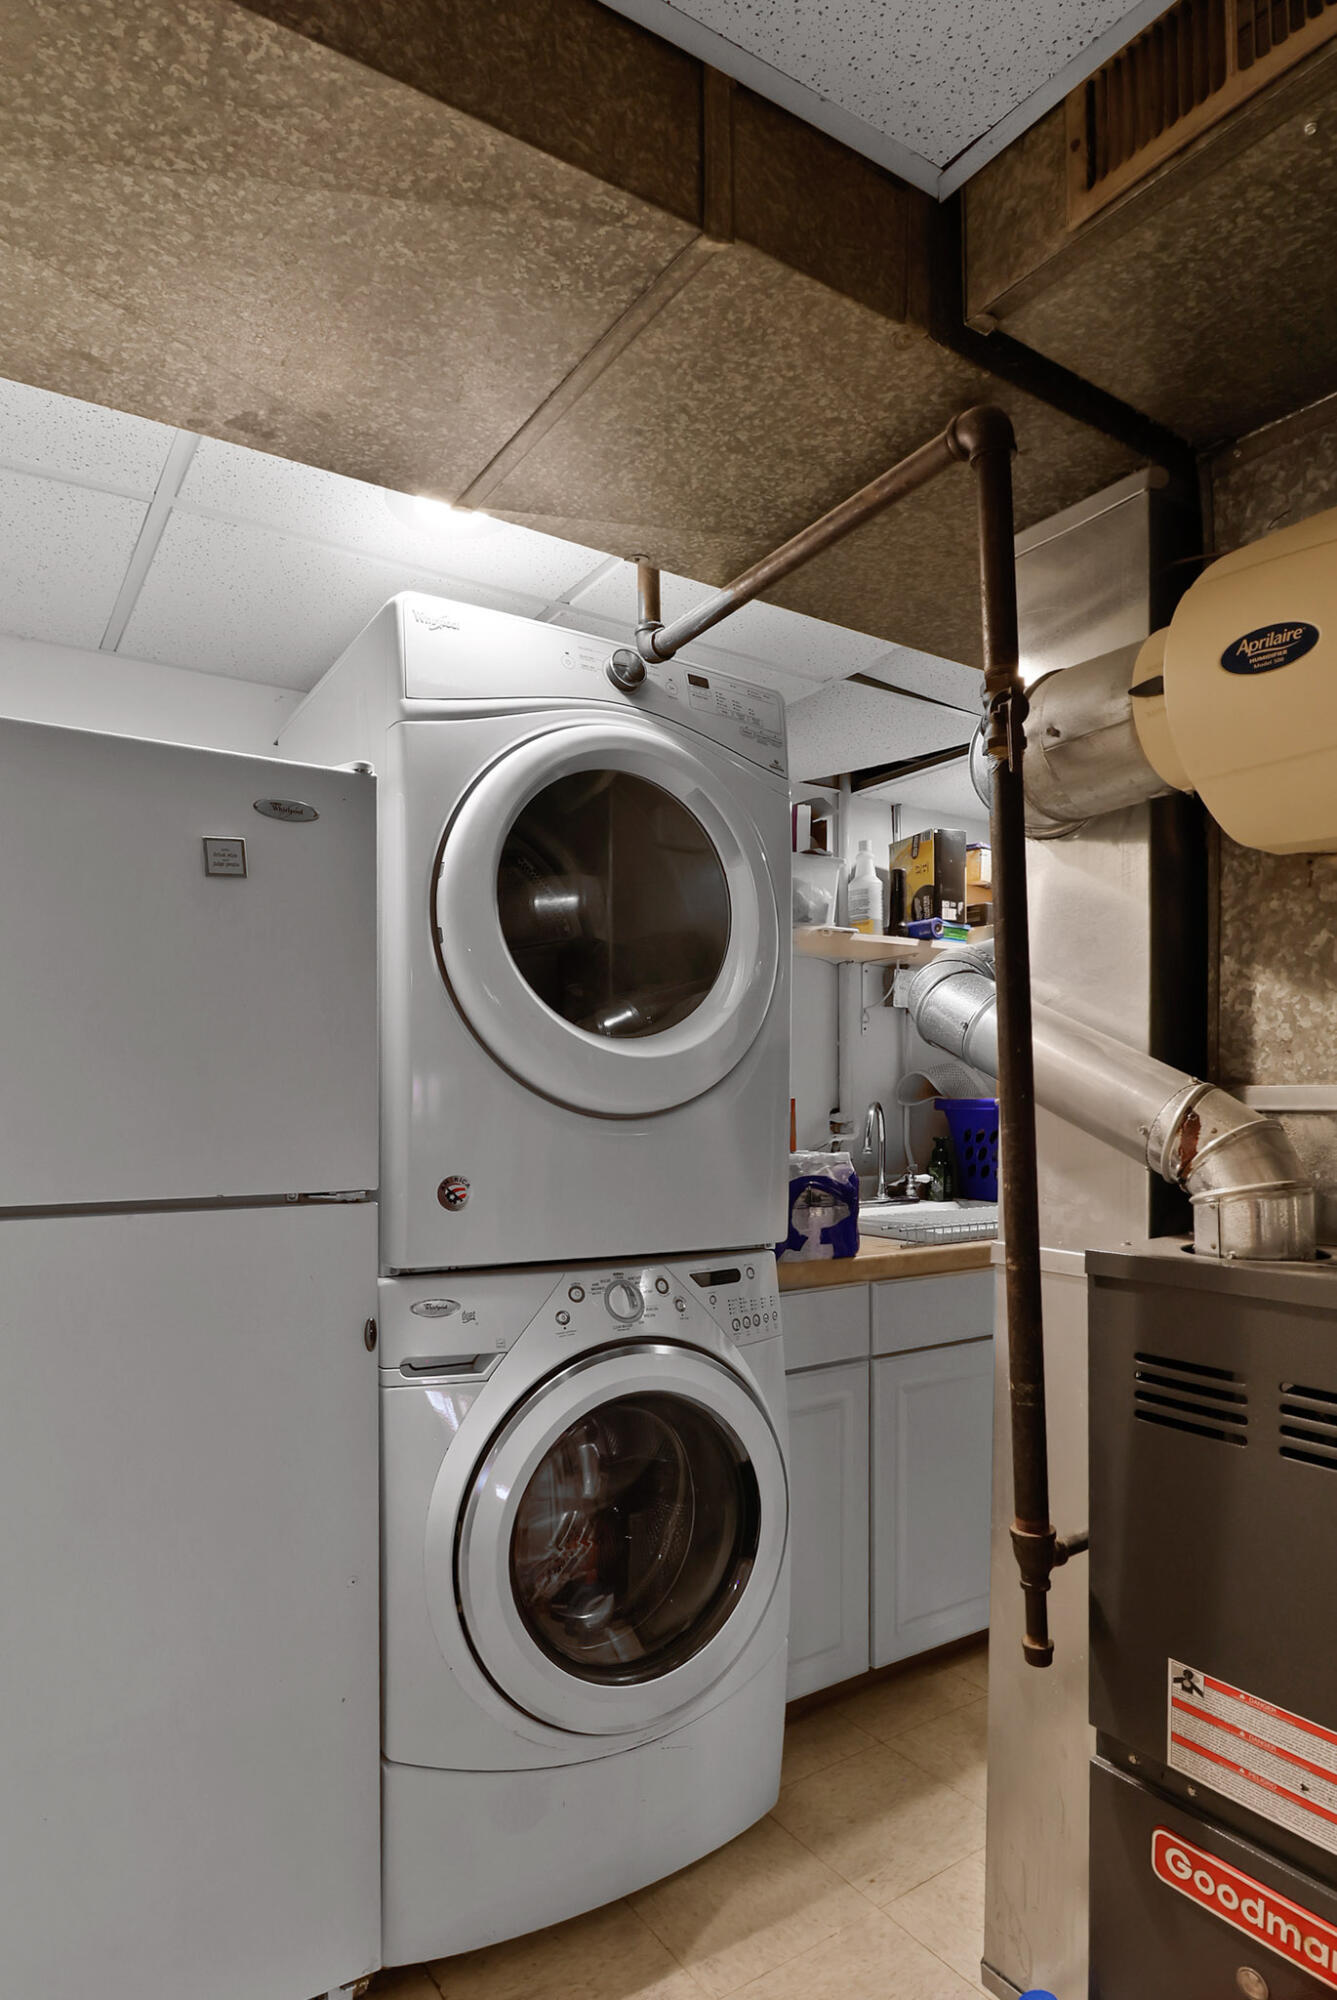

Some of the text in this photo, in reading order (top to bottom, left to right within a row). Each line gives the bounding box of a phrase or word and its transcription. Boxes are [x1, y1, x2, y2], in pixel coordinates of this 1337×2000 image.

[1236, 626, 1305, 657] Aprilaire
[1249, 649, 1288, 664] HUMIDIFIER
[1254, 659, 1273, 669] Model
[269, 801, 304, 816] Whirlpool
[1164, 1847, 1337, 1975] Goodma
